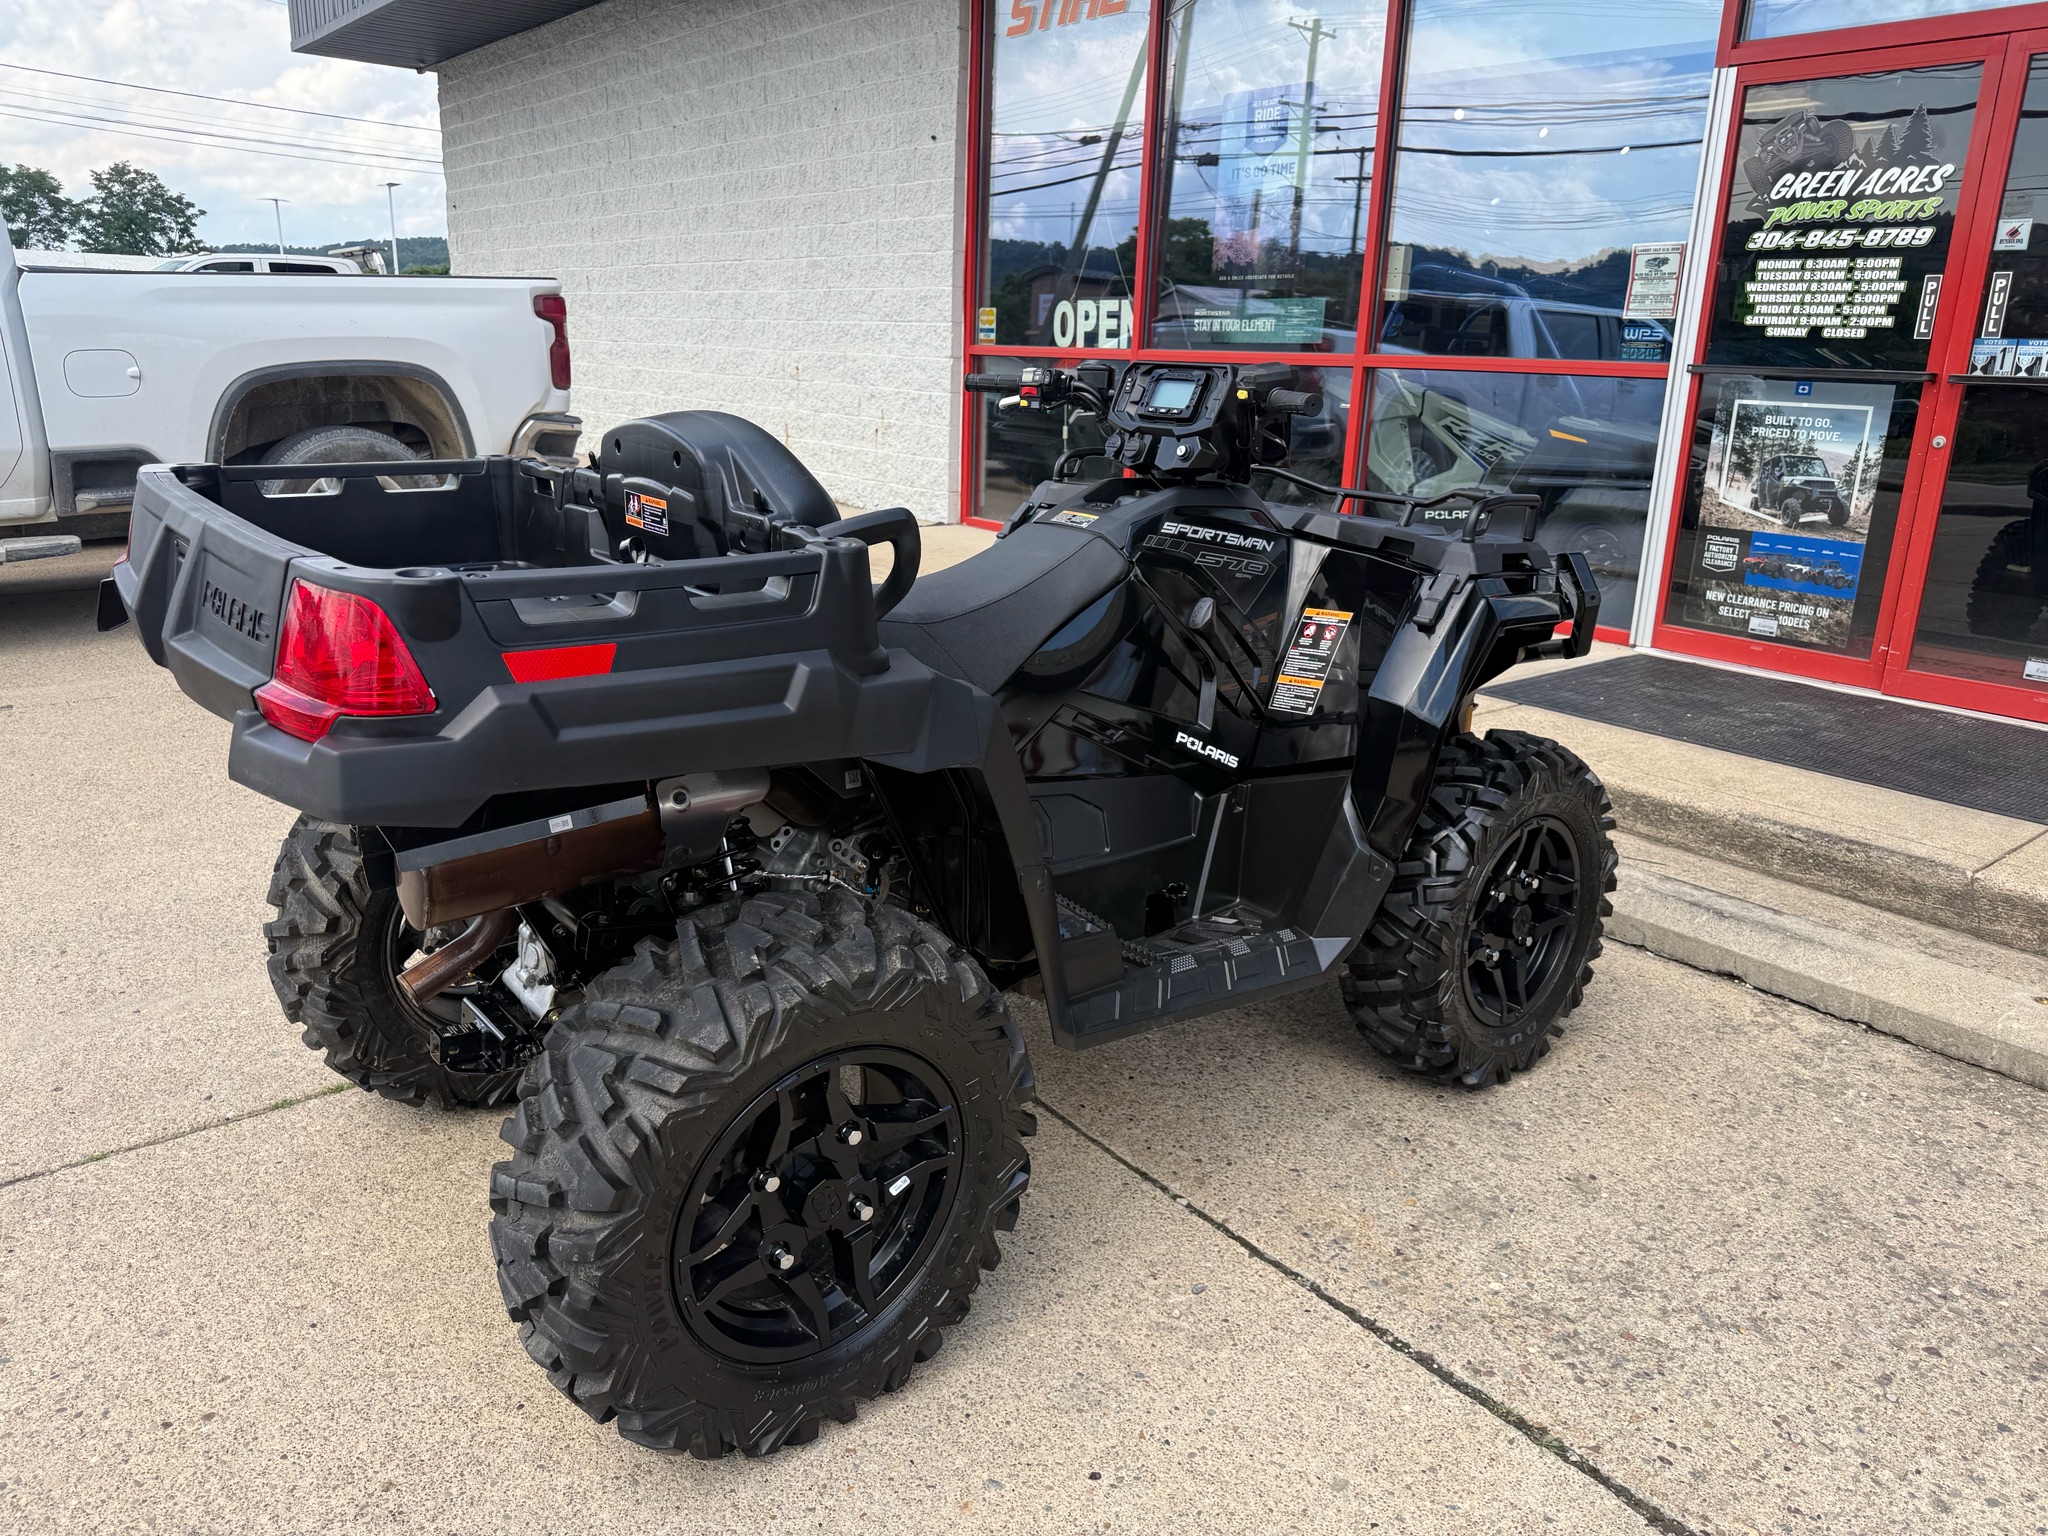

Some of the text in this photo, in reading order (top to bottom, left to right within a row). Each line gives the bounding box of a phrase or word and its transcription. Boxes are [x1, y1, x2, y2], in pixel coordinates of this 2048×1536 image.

[1255, 107, 1281, 123] RIDE
[1232, 162, 1296, 180] IT'S GO TIME
[1769, 163, 1956, 200] GREEN ACRES
[1763, 197, 1944, 229] POWER SPORTS
[1746, 227, 1935, 249] 304-845-8789
[1757, 259, 1801, 270] MONDAY
[1805, 259, 1848, 269] 8:30AM
[1856, 258, 1900, 268] 5:00PM
[1756, 271, 1801, 281] TUESDAY
[1803, 270, 1845, 280] 8:30AM
[1853, 270, 1898, 280] 5:00PM
[1746, 282, 1809, 292] WEDNESDAY
[1810, 282, 1852, 292] 8:30AM
[1860, 281, 1905, 291] 5:00PM
[1748, 294, 1802, 304] THURSDAY
[1803, 293, 1846, 303] 8:30AM
[1853, 293, 1898, 303] 5:00PM
[1988, 279, 2007, 332] PULL
[1755, 305, 1791, 315] FRIDAY
[1792, 305, 1834, 315] 8:30AM
[1842, 305, 1886, 315] 5:00PM
[1920, 282, 1938, 333] PULL
[1194, 319, 1212, 332] STAY
[1221, 319, 1241, 332] YOUR
[1241, 319, 1276, 332] ELEMENT
[1745, 316, 1798, 326] SATURDAY
[1799, 316, 1841, 326] 9:00AM
[1849, 316, 1893, 327] 2:00PM
[1624, 328, 1664, 340] WPS
[1766, 327, 1866, 338] SUNDAY CLOSED
[1765, 415, 1833, 428] BUILT TO GO.
[1751, 427, 1843, 442] PRICED TO MOVE.
[1160, 521, 1275, 552] SPORTSMAN
[1706, 534, 1740, 544] POLARIS
[1708, 544, 1735, 554] FACTORY
[1194, 551, 1269, 576] 570
[1703, 551, 1738, 562] AUTHORIZED
[1705, 558, 1734, 568] CLEARANCE
[1705, 590, 1726, 603] NEW
[1726, 592, 1777, 611] CLEARANCE
[1778, 601, 1815, 616] PRICING
[1816, 607, 1830, 619] ON
[202, 580, 272, 647] POLARIS
[1718, 605, 1750, 620] SELECT
[1175, 731, 1240, 768] POLARIS
